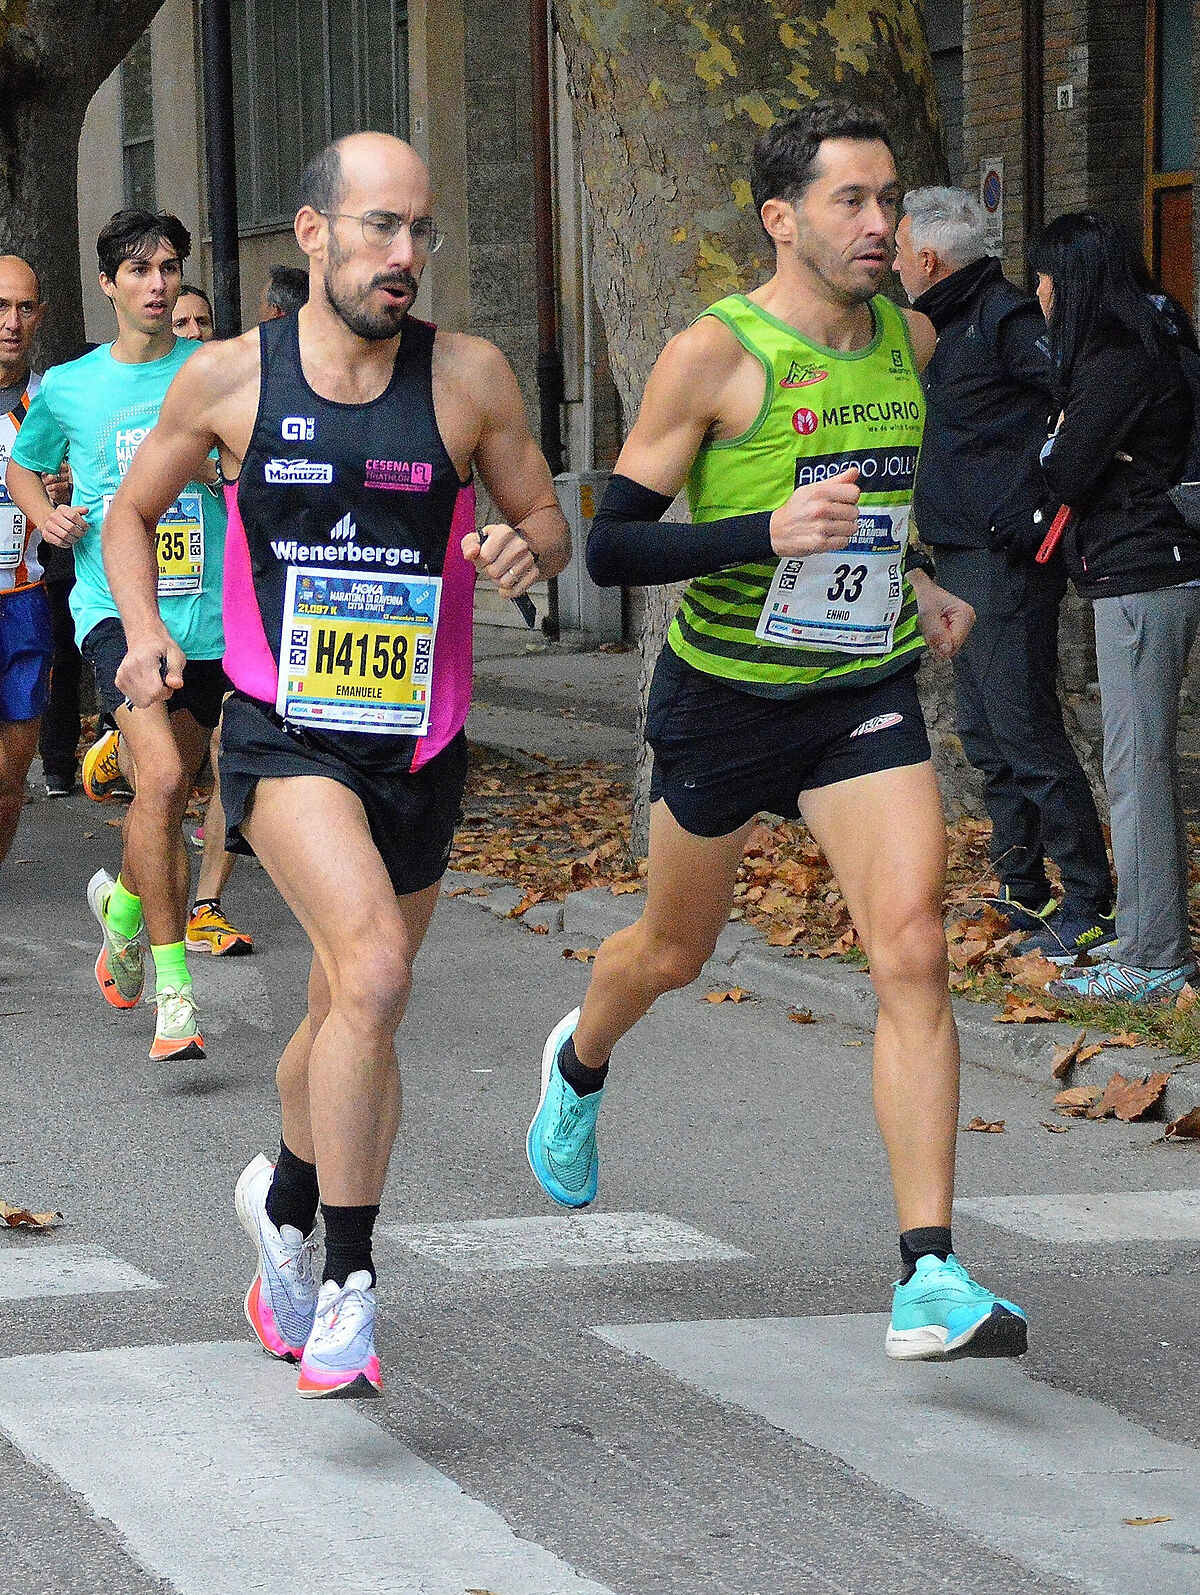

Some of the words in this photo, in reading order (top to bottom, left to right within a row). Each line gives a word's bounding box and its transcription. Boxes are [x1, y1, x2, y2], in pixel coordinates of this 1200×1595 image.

[822, 401, 920, 428] MERCURIO
[365, 459, 410, 472] CESENA
[268, 469, 329, 480] Manuzzi
[270, 541, 421, 566] Wienerberger
[351, 582, 384, 596] HOKA
[826, 564, 868, 603] 33
[329, 591, 366, 604] MARATONA
[365, 593, 375, 604] DI
[373, 594, 404, 607] RAVENNA
[415, 590, 430, 605] BLU
[330, 605, 338, 616] K
[826, 610, 850, 621] ENNIO
[315, 629, 408, 681] H4158
[336, 685, 383, 699] EMANUELE
